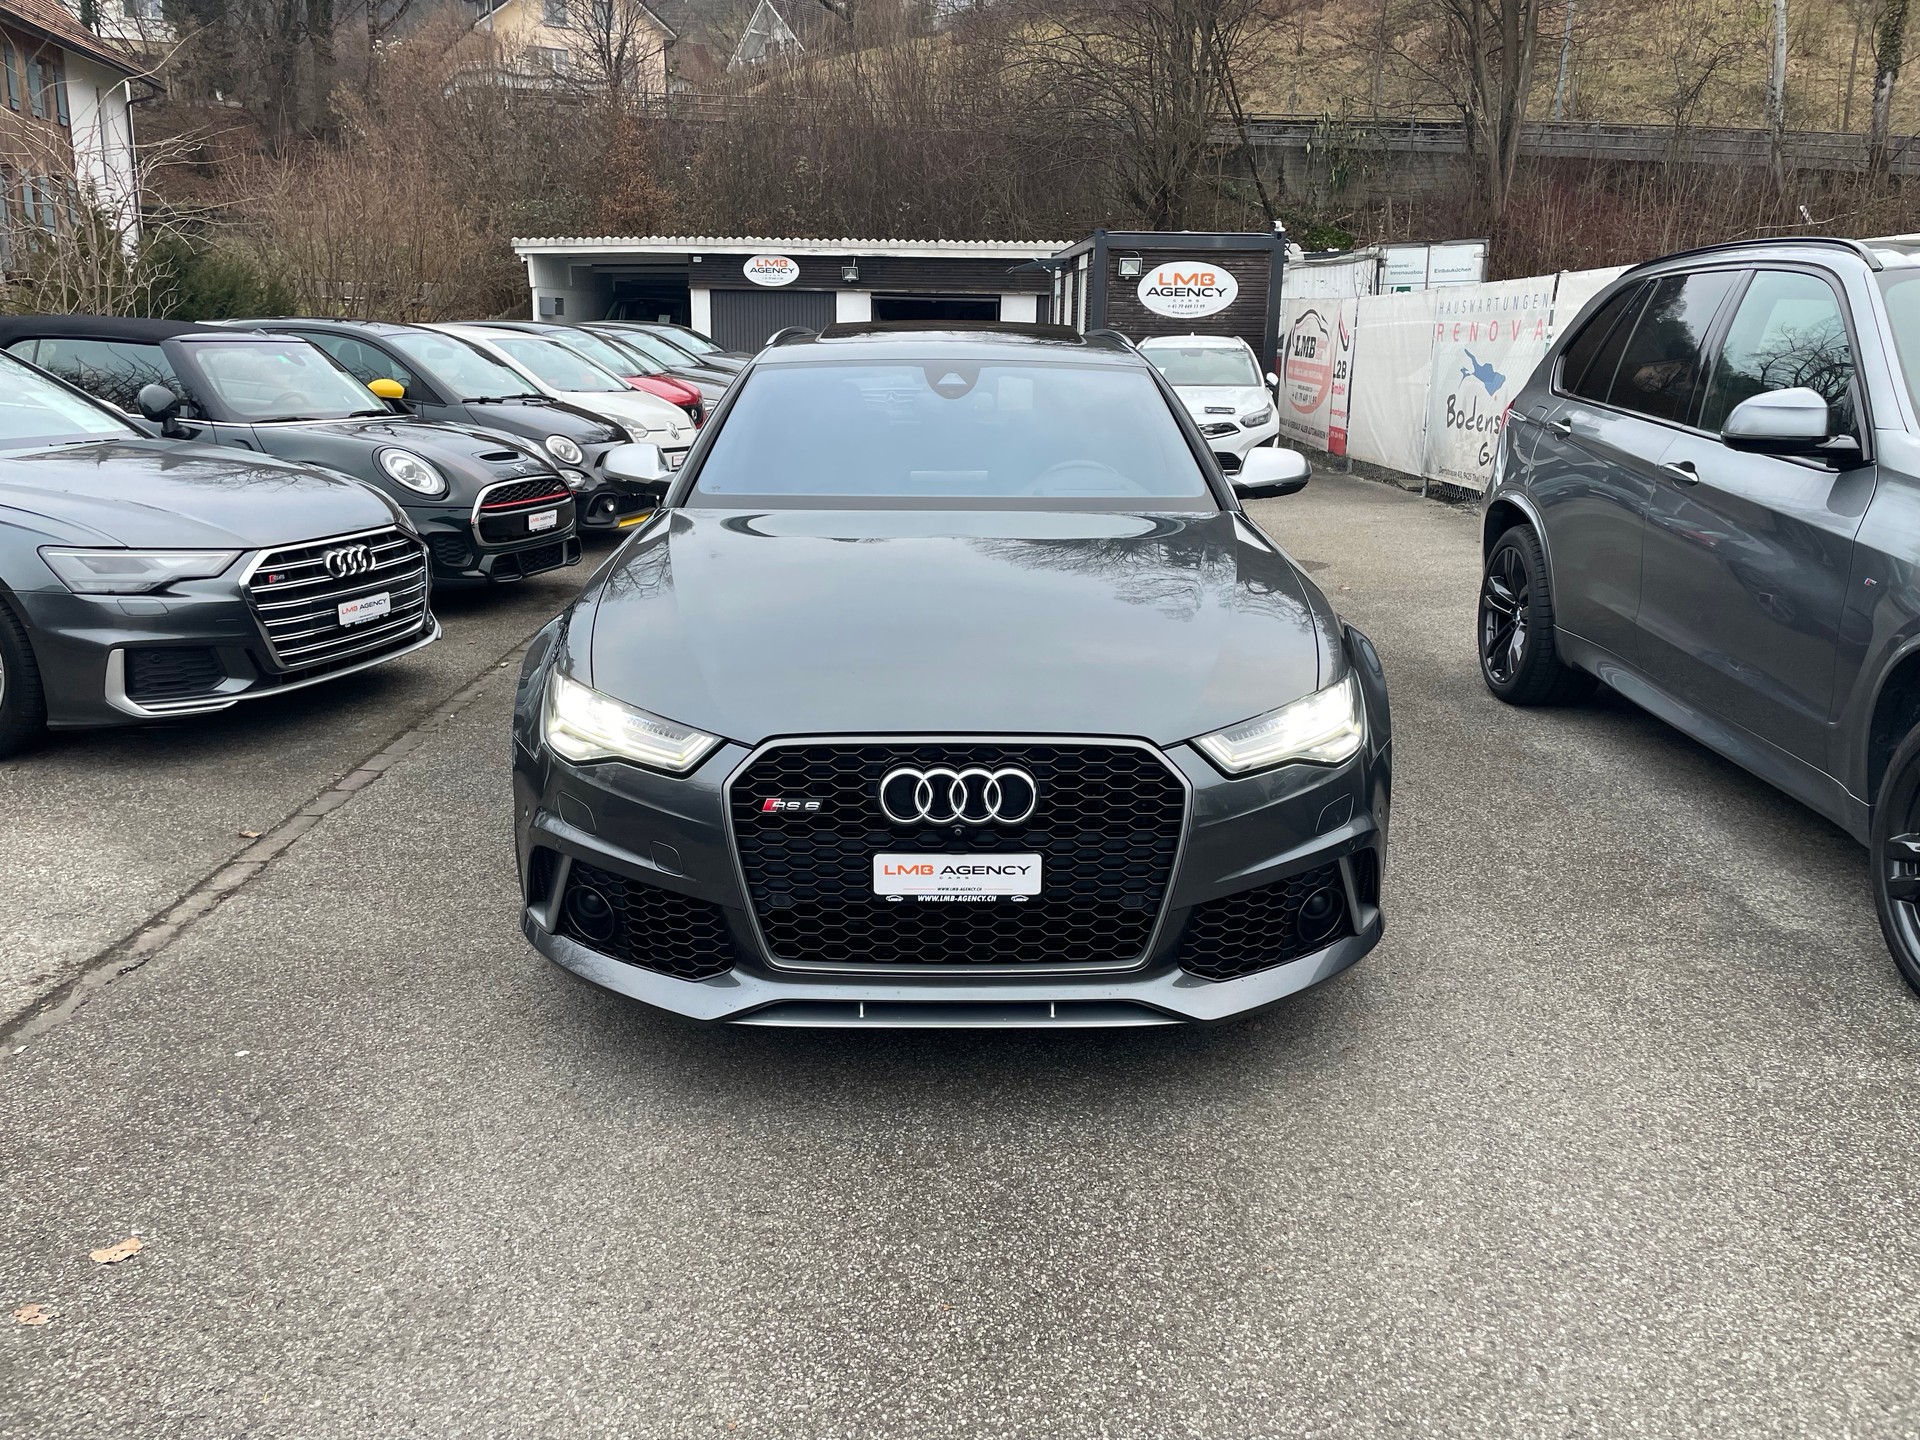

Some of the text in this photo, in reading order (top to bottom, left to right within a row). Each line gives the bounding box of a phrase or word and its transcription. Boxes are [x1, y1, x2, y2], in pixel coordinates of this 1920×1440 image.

[756, 259, 788, 267] LMB
[1158, 272, 1216, 286] LMB
[1145, 287, 1228, 297] AGENCY
[1440, 293, 1549, 315] HAUSWARTUNGEN
[1436, 319, 1544, 342] RENOVA
[1294, 335, 1316, 358] LMB
[341, 605, 358, 615] LMB
[359, 598, 387, 610] AGENCY
[767, 799, 820, 811] RS 6
[884, 864, 1031, 875] LMB AGENCY
